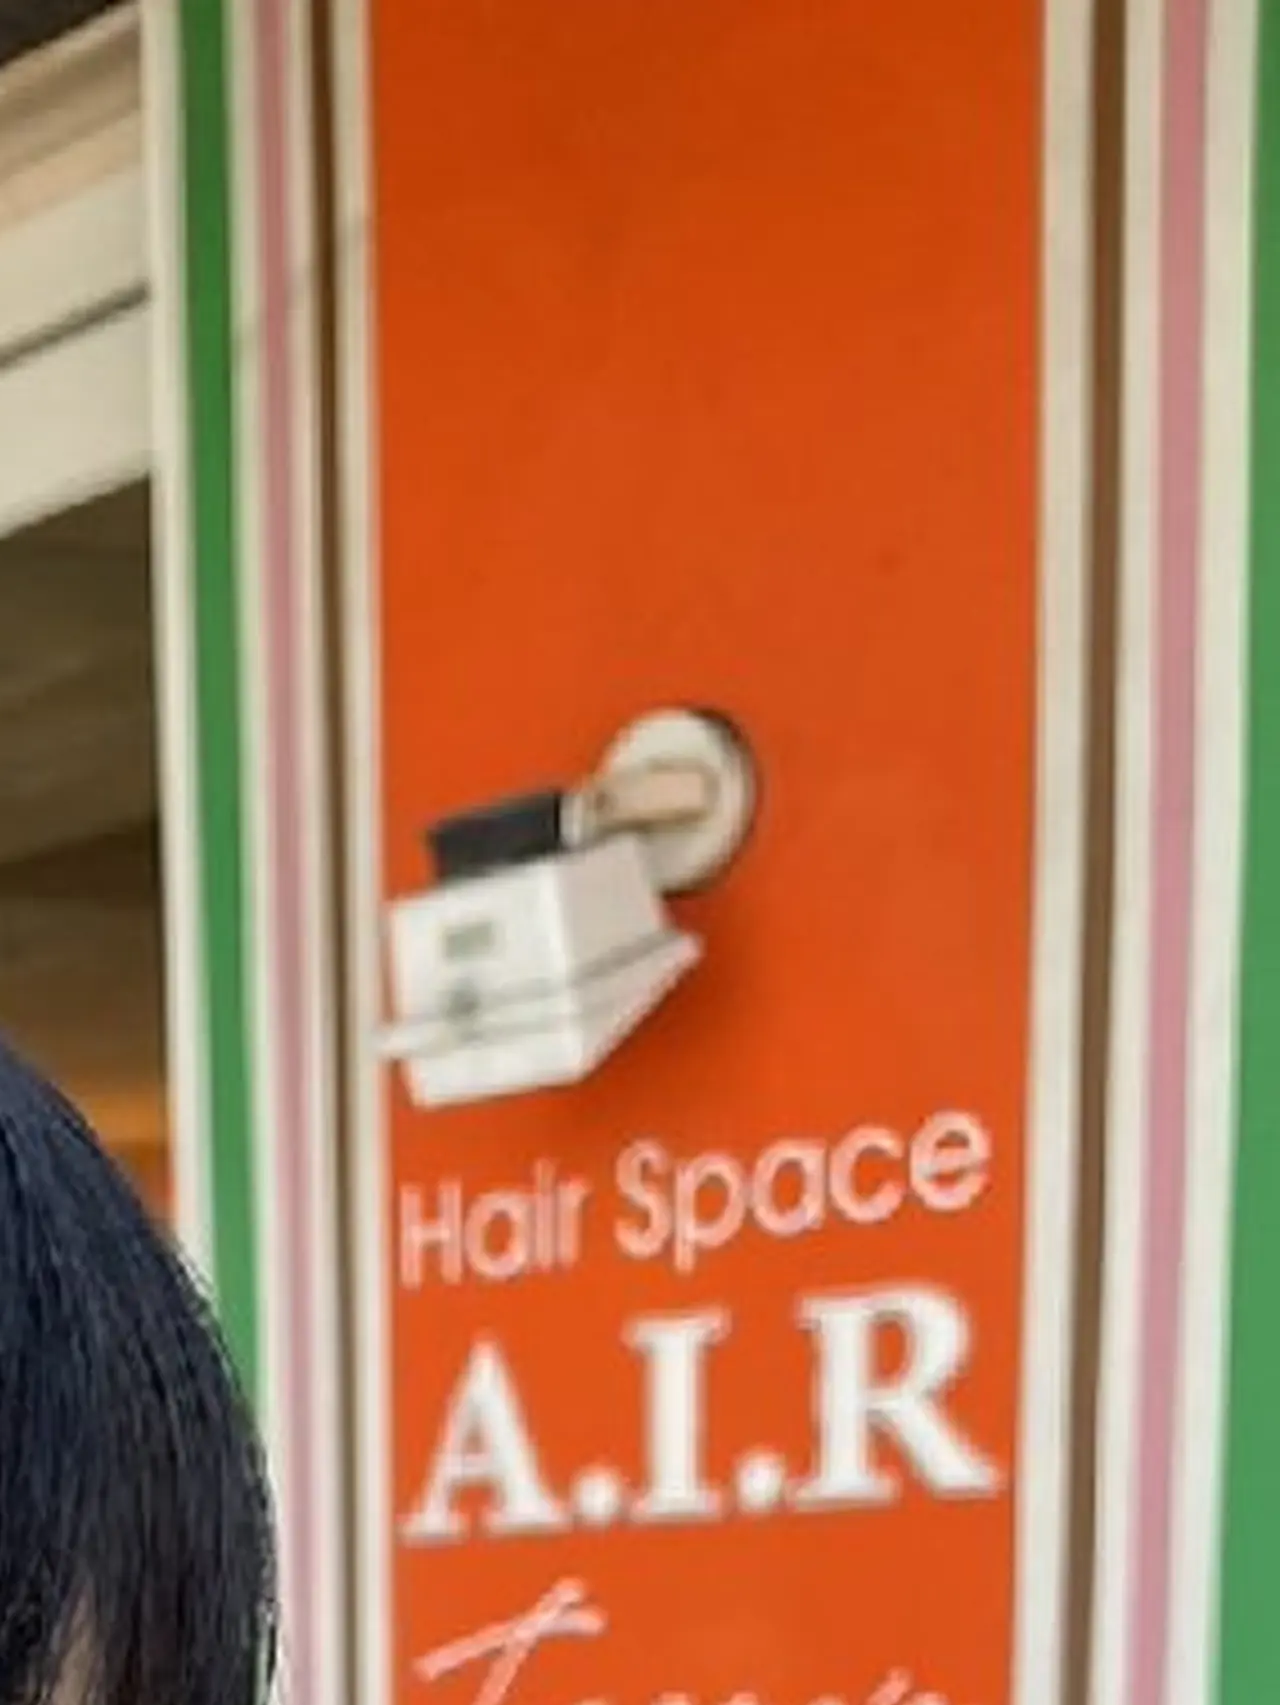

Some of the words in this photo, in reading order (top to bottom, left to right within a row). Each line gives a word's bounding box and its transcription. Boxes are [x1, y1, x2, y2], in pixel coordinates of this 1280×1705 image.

[399, 1160, 586, 1289] Hair
[614, 1109, 994, 1273] Space
[398, 1282, 1002, 1546] A.I.R
